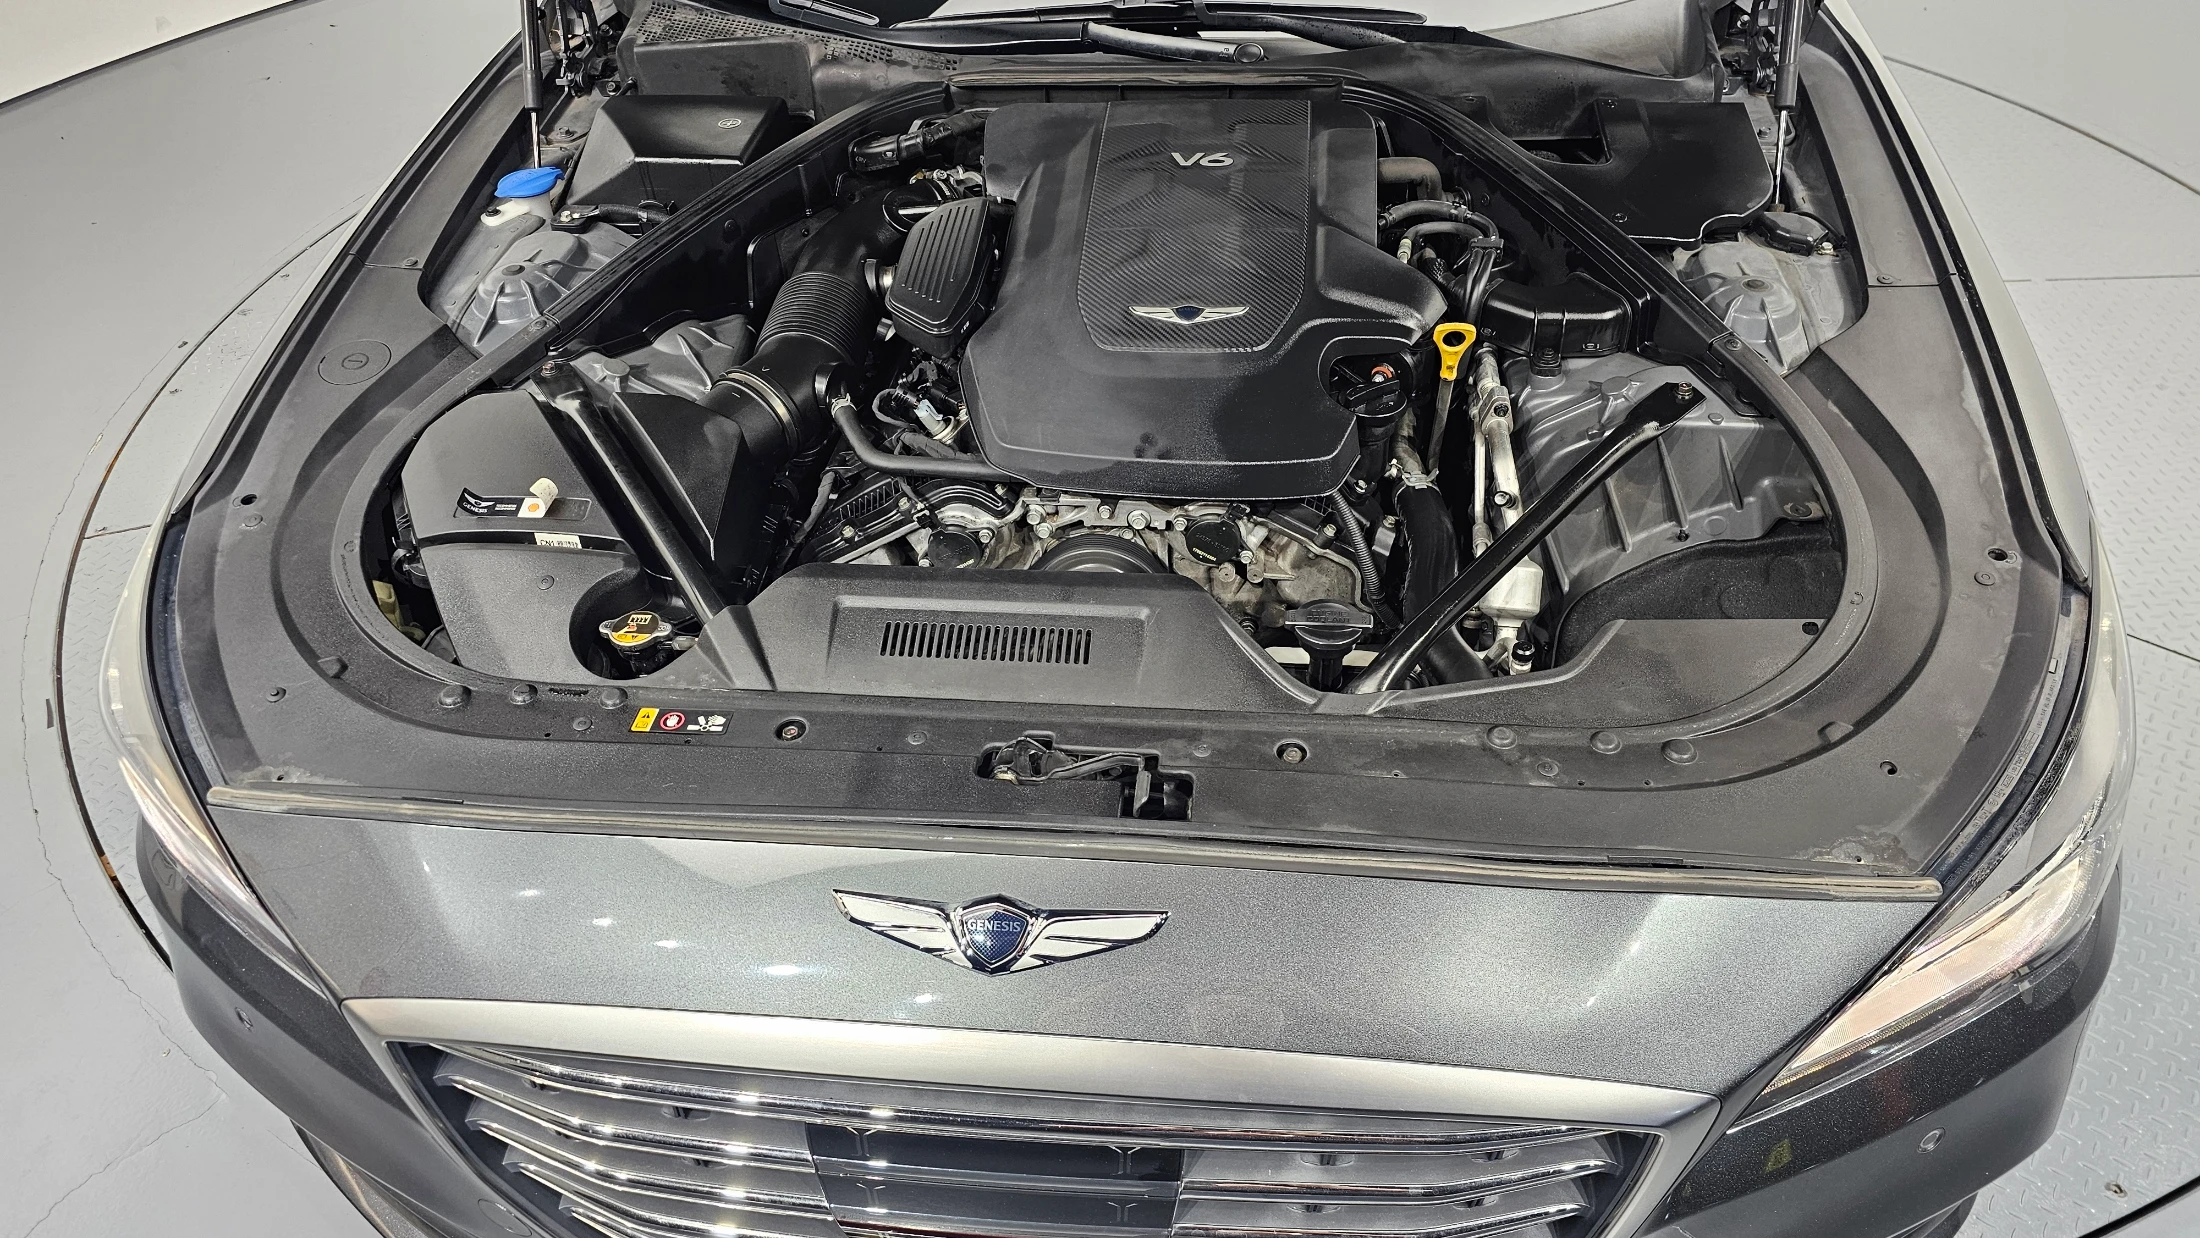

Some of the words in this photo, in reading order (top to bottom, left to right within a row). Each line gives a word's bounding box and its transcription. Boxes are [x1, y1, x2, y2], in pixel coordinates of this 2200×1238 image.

[1171, 152, 1234, 167] V6
[463, 502, 488, 513] GENESIS
[967, 919, 1021, 932] GENESIS
